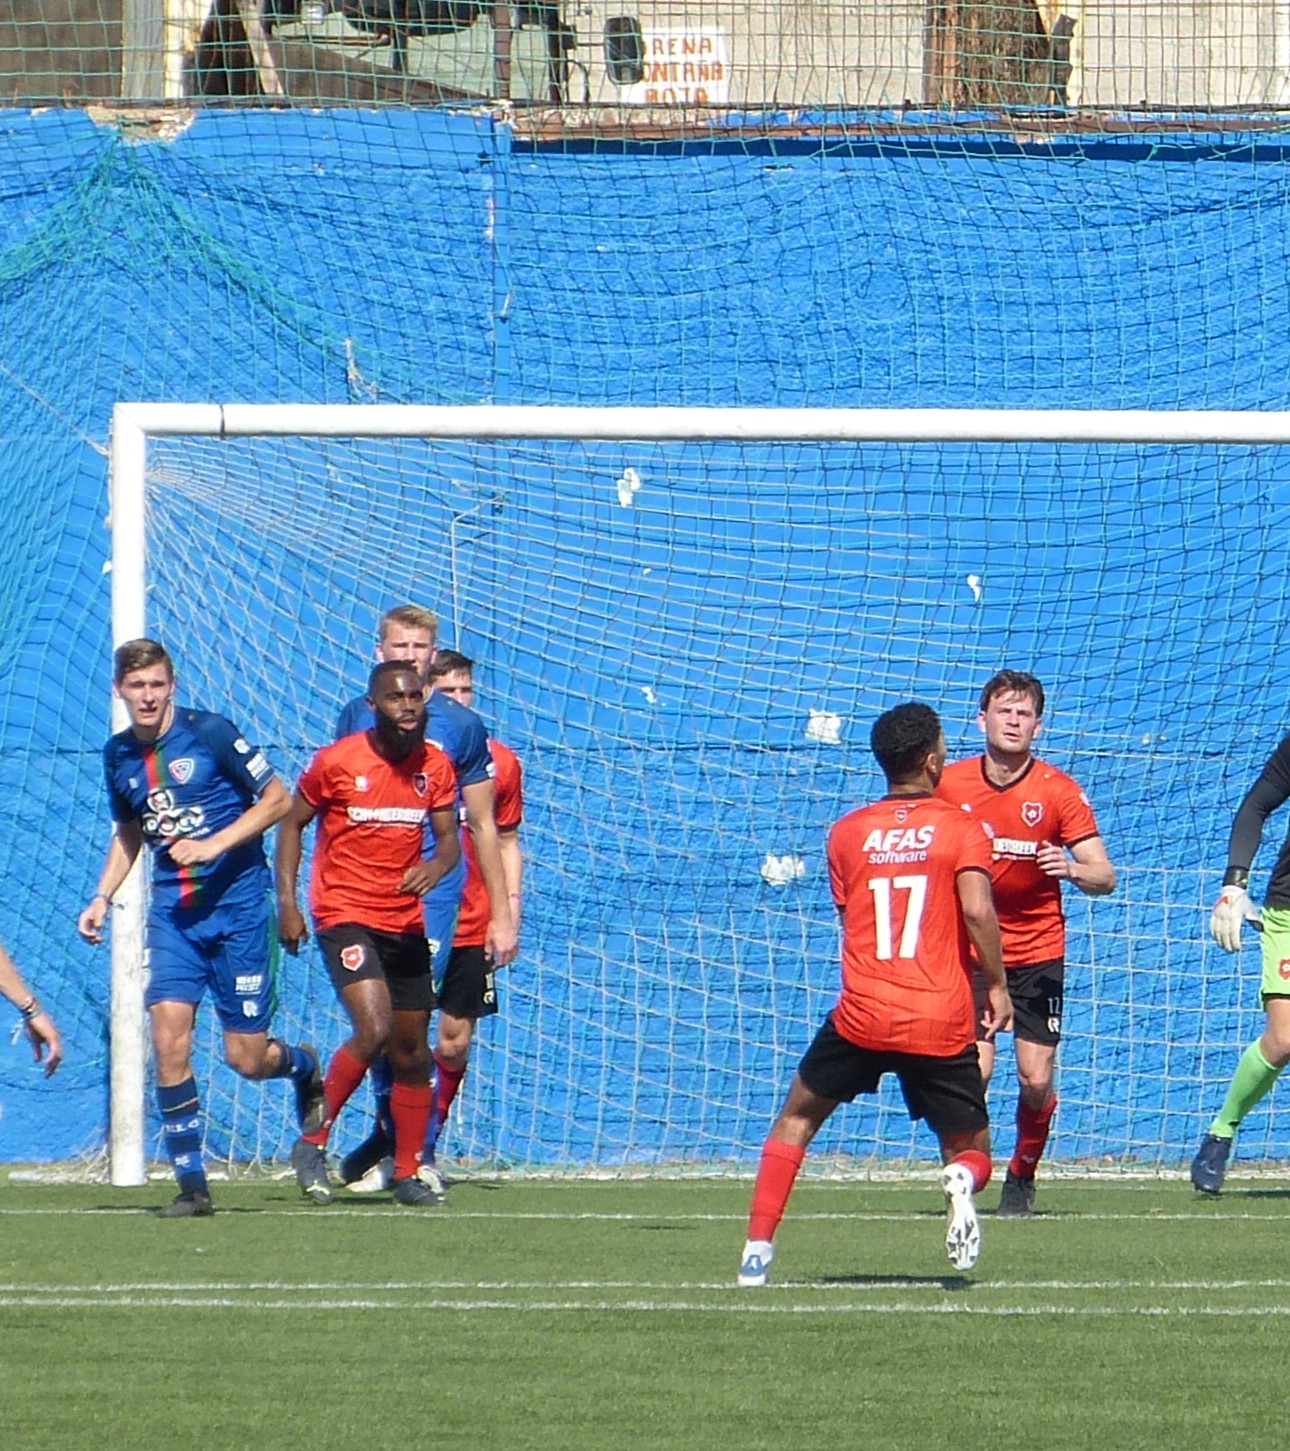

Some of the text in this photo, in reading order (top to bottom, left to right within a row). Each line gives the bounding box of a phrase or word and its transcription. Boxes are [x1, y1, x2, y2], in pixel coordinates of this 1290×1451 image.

[641, 60, 723, 82] ONTAÑA
[862, 825, 935, 852] AFAS
[868, 849, 927, 864] software
[868, 875, 928, 960] 17
